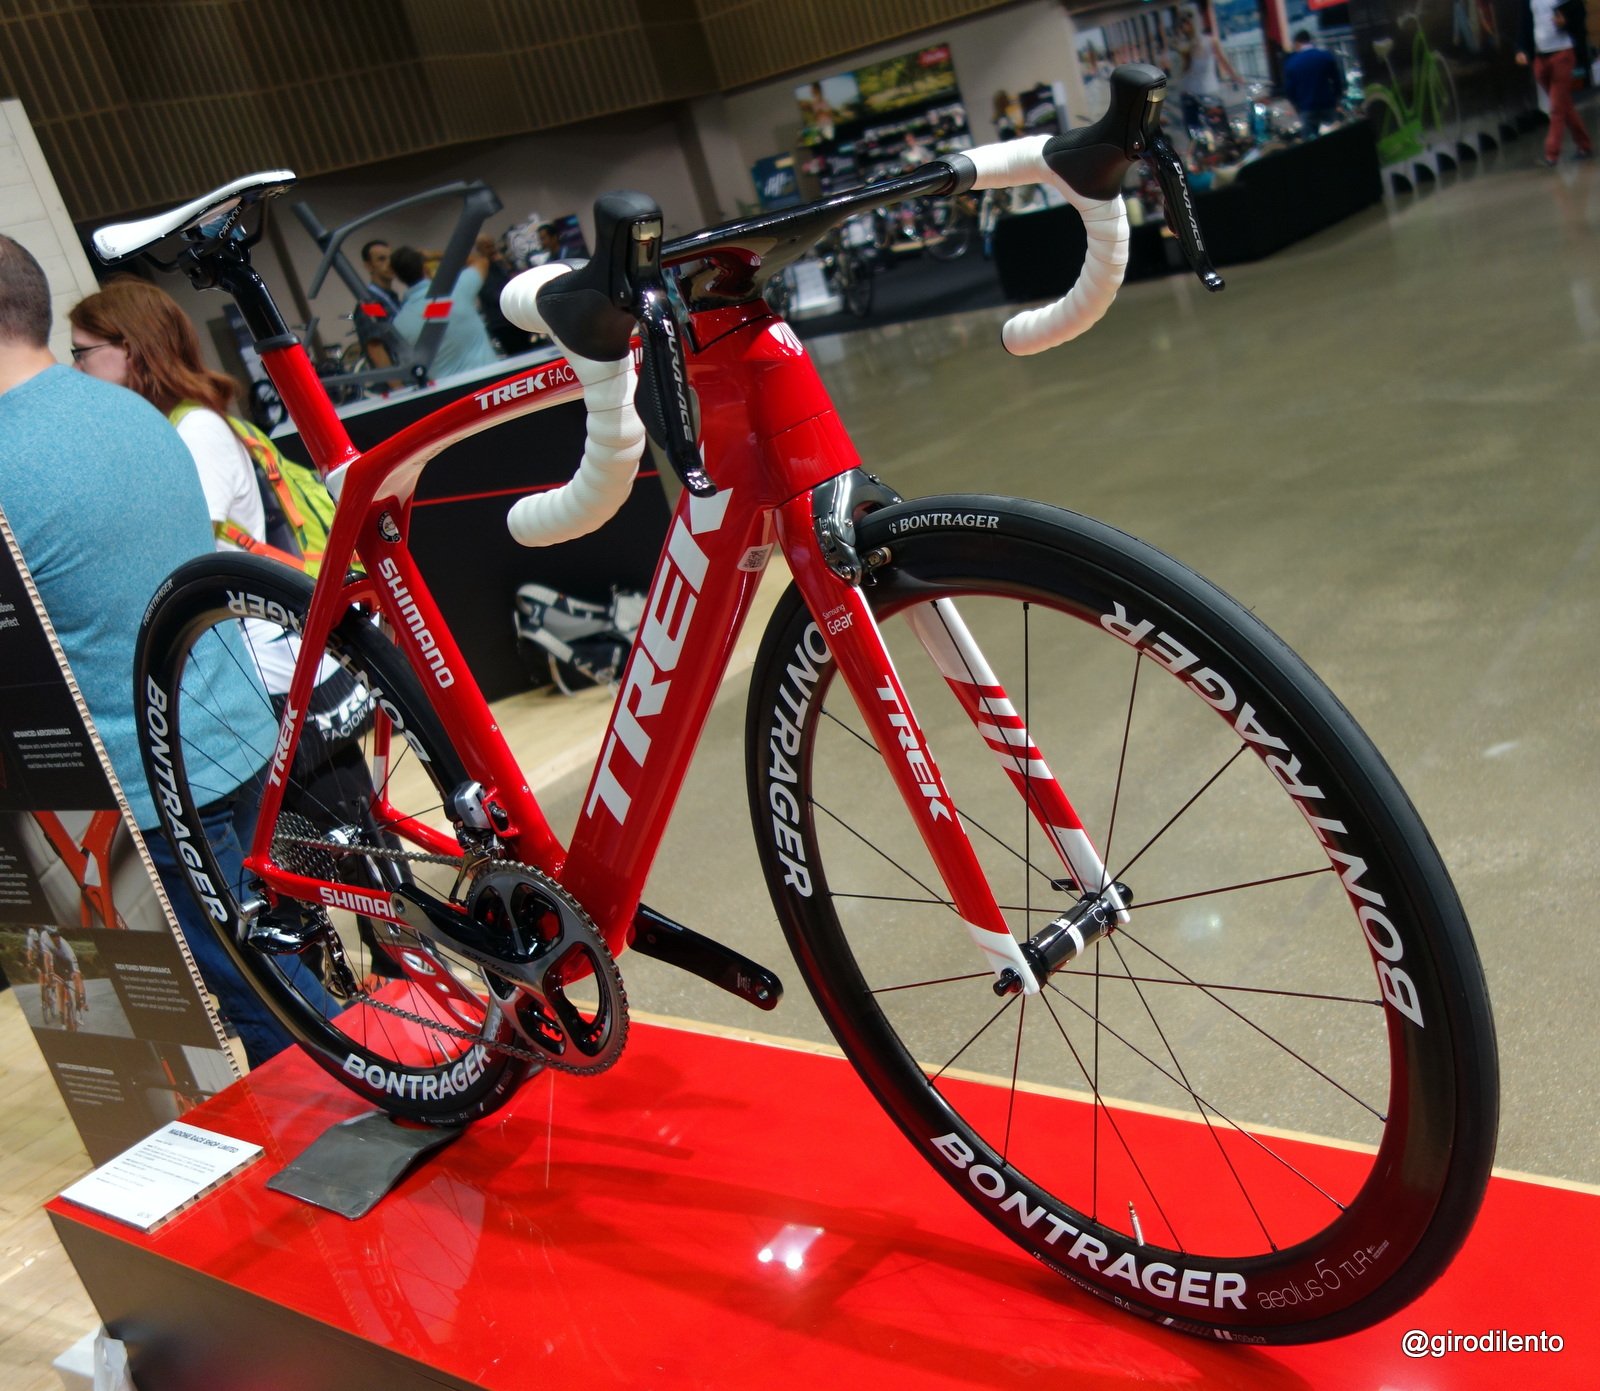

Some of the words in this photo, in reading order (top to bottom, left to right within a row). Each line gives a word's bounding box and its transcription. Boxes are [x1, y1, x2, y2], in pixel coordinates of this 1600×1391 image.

[1173, 161, 1205, 252] DURA-ACE
[474, 372, 547, 411] TREK
[547, 364, 576, 387] FAC
[662, 318, 694, 444] DURA-ACE
[899, 513, 1000, 533] BONTRAGER
[144, 578, 173, 623] BONTRAGER
[378, 557, 455, 689] SHIMANO
[586, 440, 734, 827] TREK
[822, 603, 846, 620] Samsung
[827, 612, 854, 636] Gear
[267, 704, 300, 788] TREK
[769, 621, 834, 900] ONTRAGER
[876, 674, 953, 823] TREK
[146, 674, 229, 923] BONTRAGER
[1101, 600, 1424, 1028] BONTRAGER
[319, 886, 397, 919] SHIMA
[342, 1044, 492, 1101] BONTRAGER
[930, 1132, 1248, 1311] BONTRAGER
[1256, 1278, 1325, 1311] aeolus
[1314, 1258, 1342, 1290] 5
[1338, 1249, 1374, 1282] TLR
